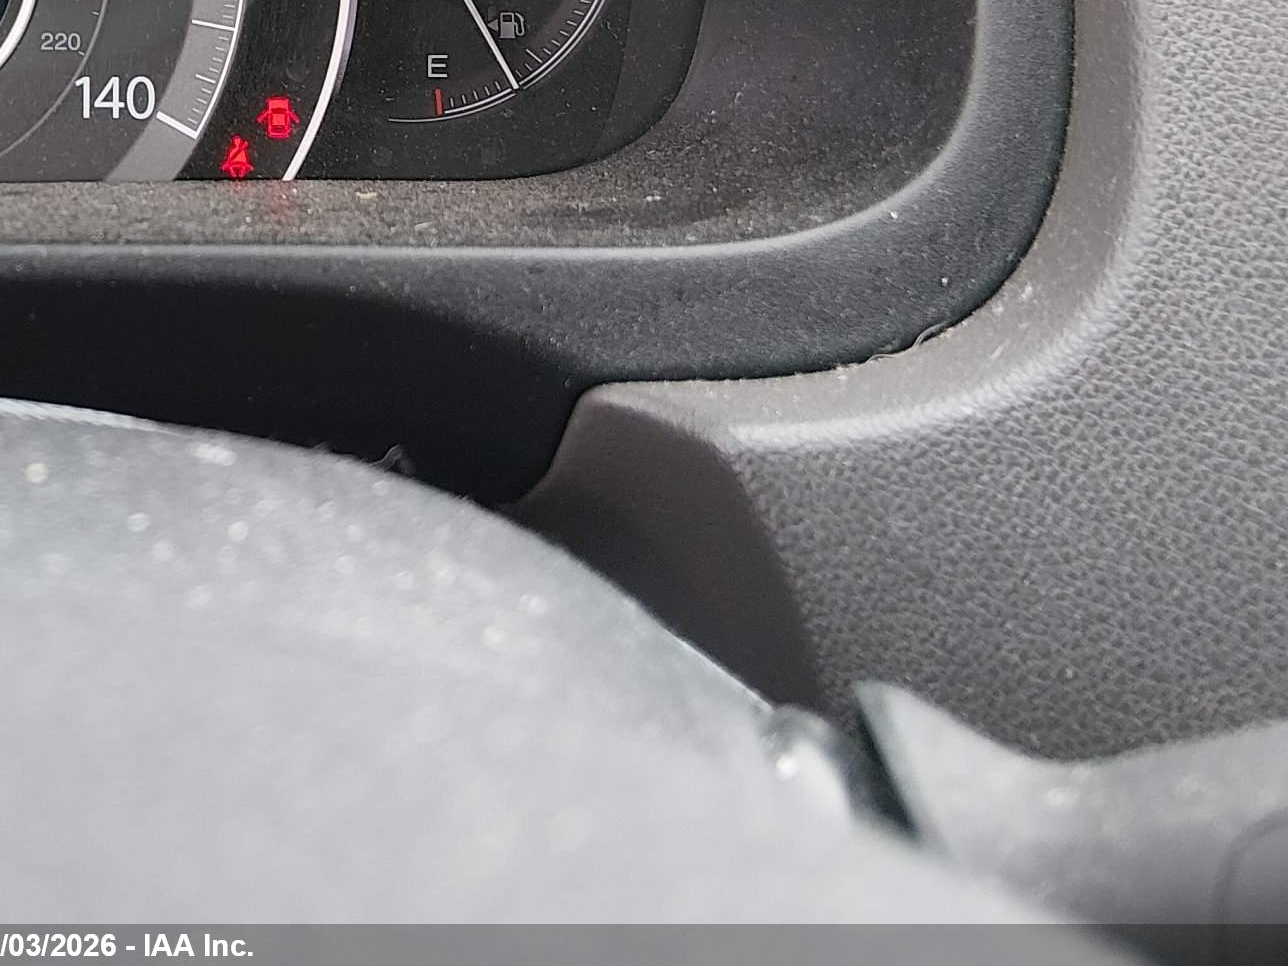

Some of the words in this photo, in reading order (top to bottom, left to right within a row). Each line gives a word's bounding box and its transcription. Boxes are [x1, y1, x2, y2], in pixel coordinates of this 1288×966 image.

[40, 33, 81, 52] 220
[427, 55, 448, 77] E
[74, 76, 156, 120] 140
